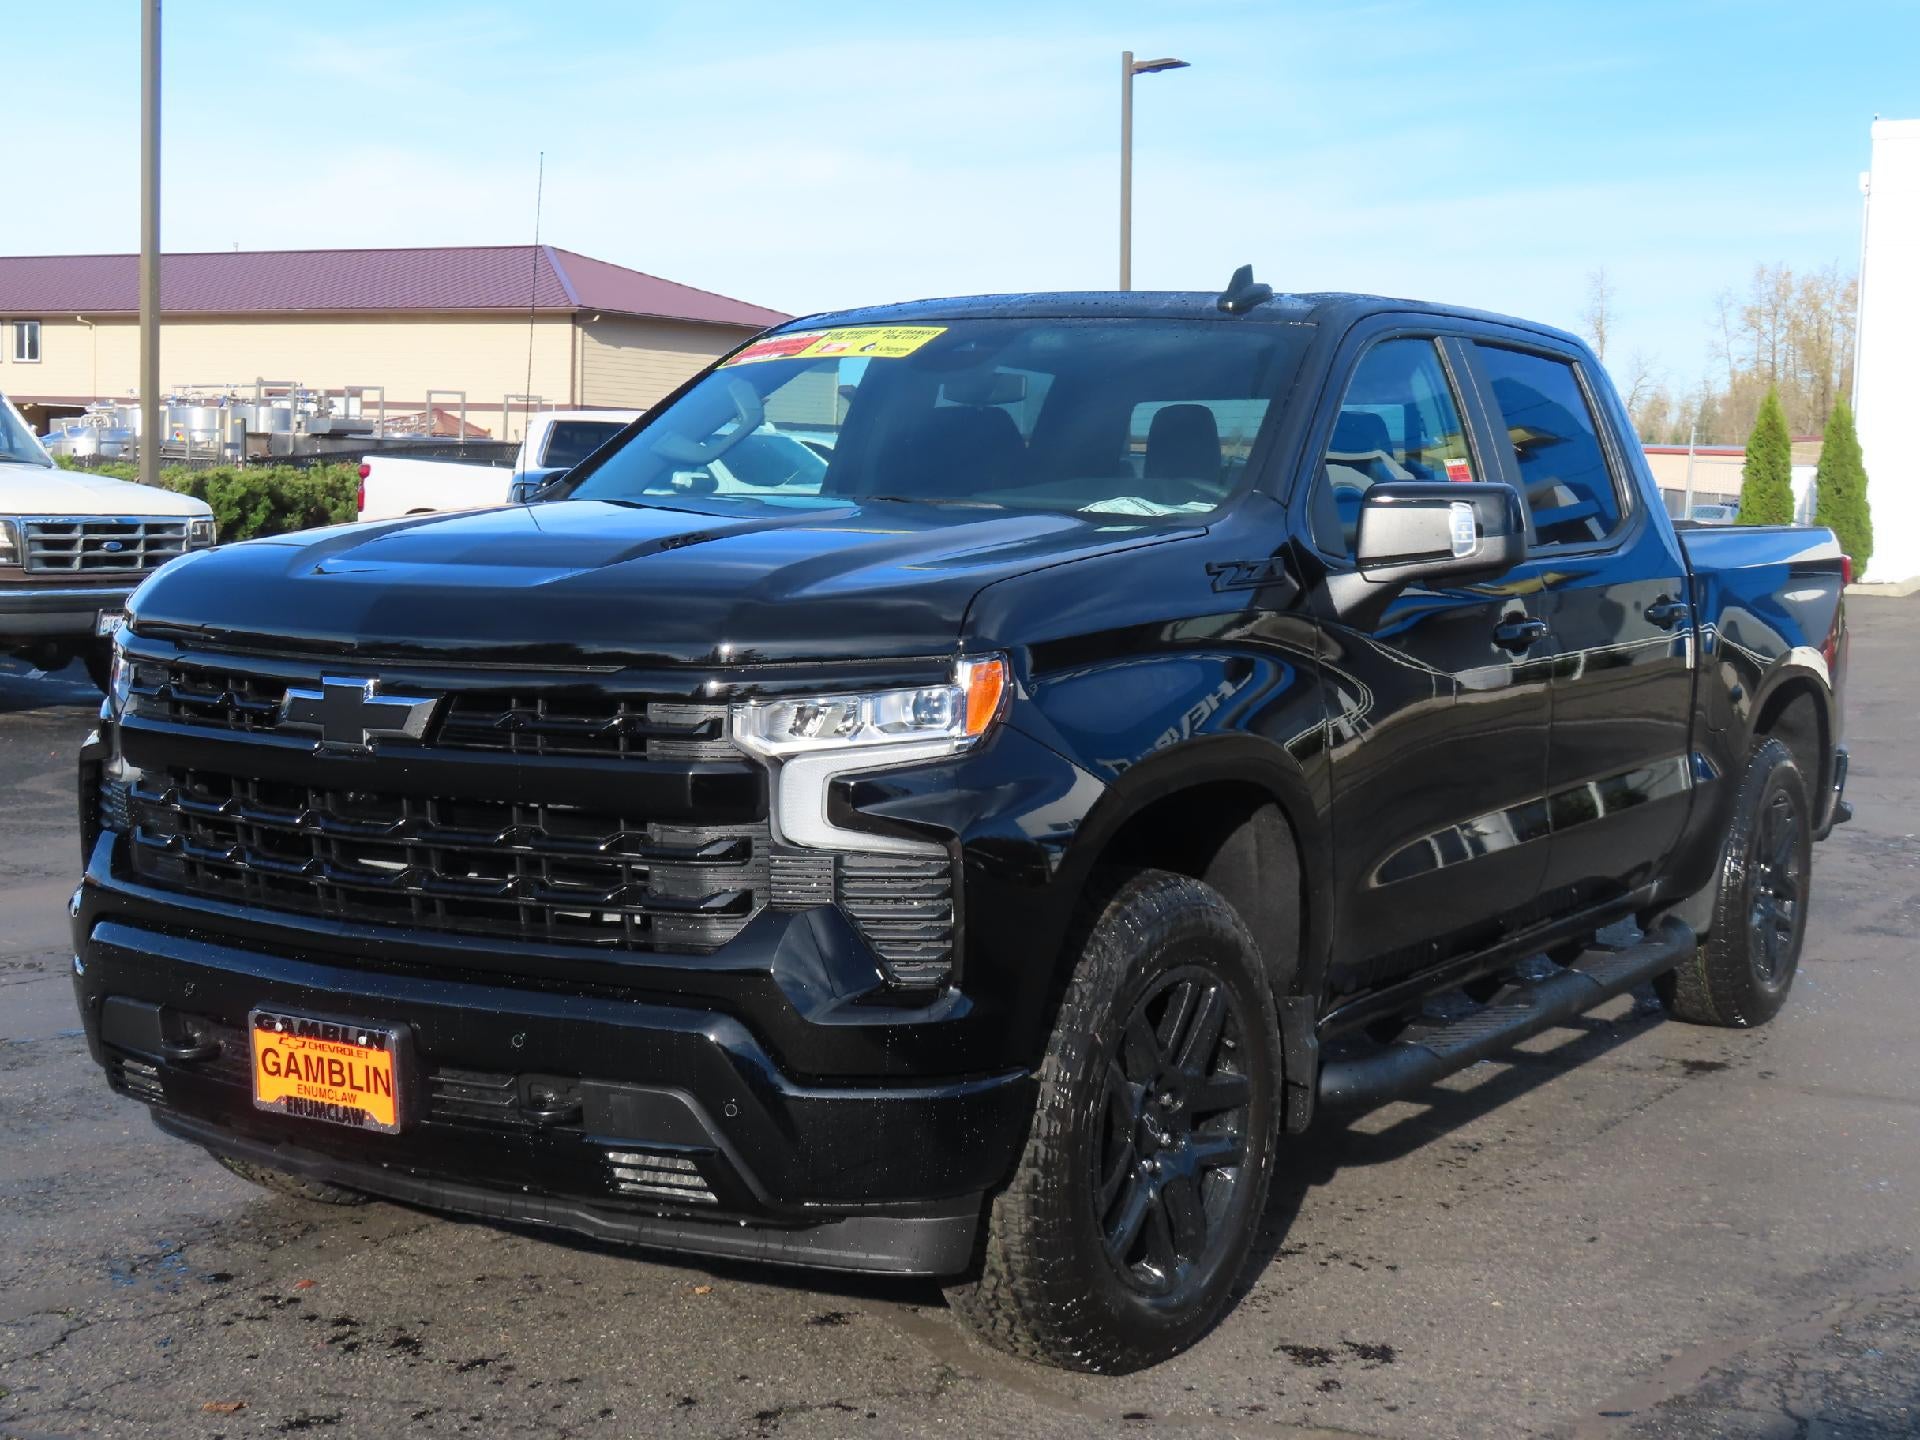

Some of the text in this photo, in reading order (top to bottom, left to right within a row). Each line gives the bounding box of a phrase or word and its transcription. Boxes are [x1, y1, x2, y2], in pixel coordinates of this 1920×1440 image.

[254, 1013, 387, 1053] GAMBLIN
[308, 1041, 369, 1060] CHEVROLET
[261, 1047, 392, 1098] GAMBLIN
[297, 1084, 358, 1105] ENUMCLAW
[286, 1095, 366, 1126] ENUMCLAW
